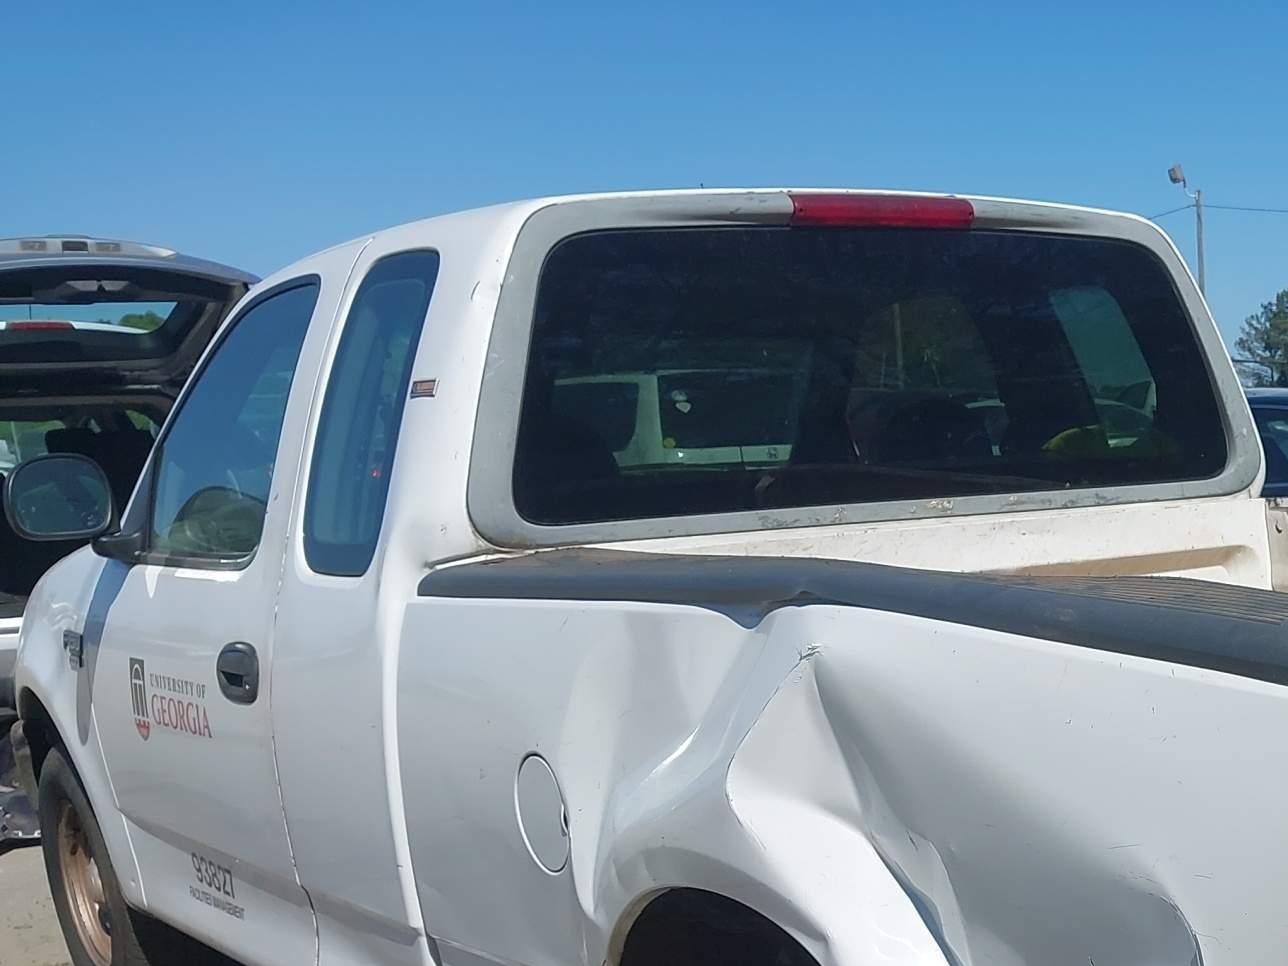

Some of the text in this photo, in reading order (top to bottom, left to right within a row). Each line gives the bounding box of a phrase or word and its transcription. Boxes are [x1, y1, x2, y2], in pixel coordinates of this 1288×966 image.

[150, 672, 205, 698] UNIVERSITY OF
[151, 694, 212, 738] GEORGIA
[191, 852, 235, 899] 93827
